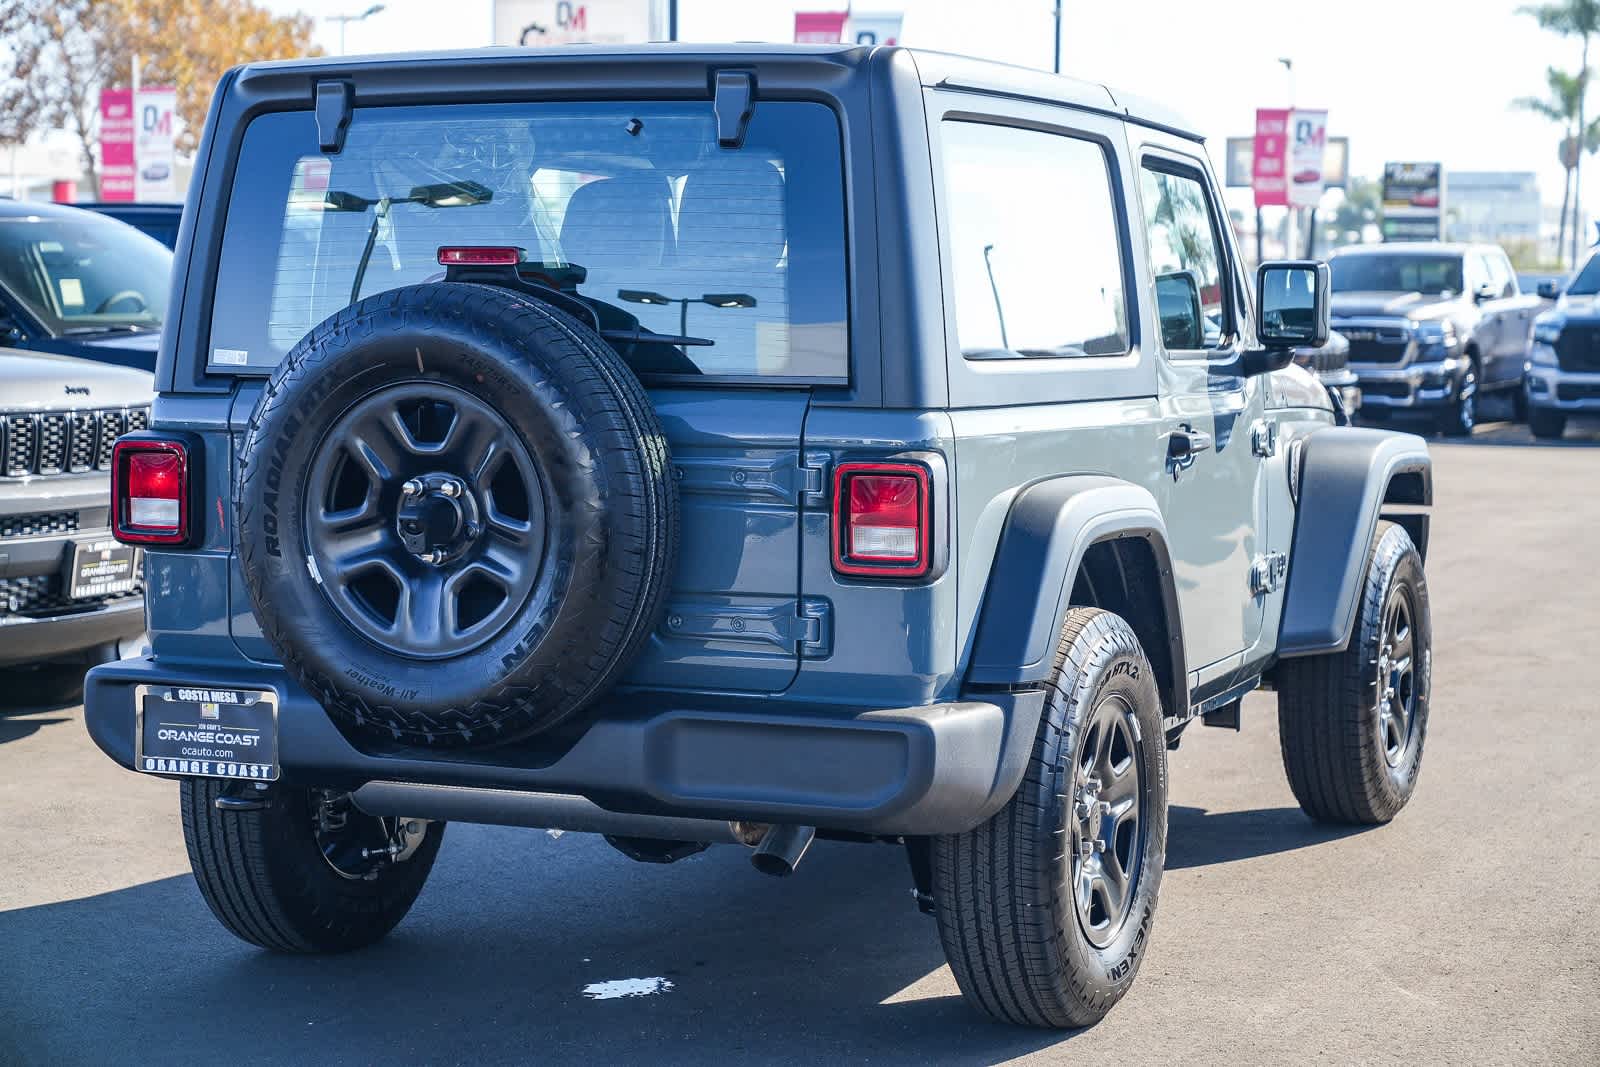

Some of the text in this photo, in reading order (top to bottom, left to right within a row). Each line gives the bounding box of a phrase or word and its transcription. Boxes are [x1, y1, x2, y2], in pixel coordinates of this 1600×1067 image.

[343, 668, 419, 701] All-Weather
[178, 689, 239, 704] COSTA MESA
[181, 745, 234, 758] ocauto.com
[146, 758, 270, 778] ORANGE COAST
[1110, 905, 1151, 981] NEXEN
